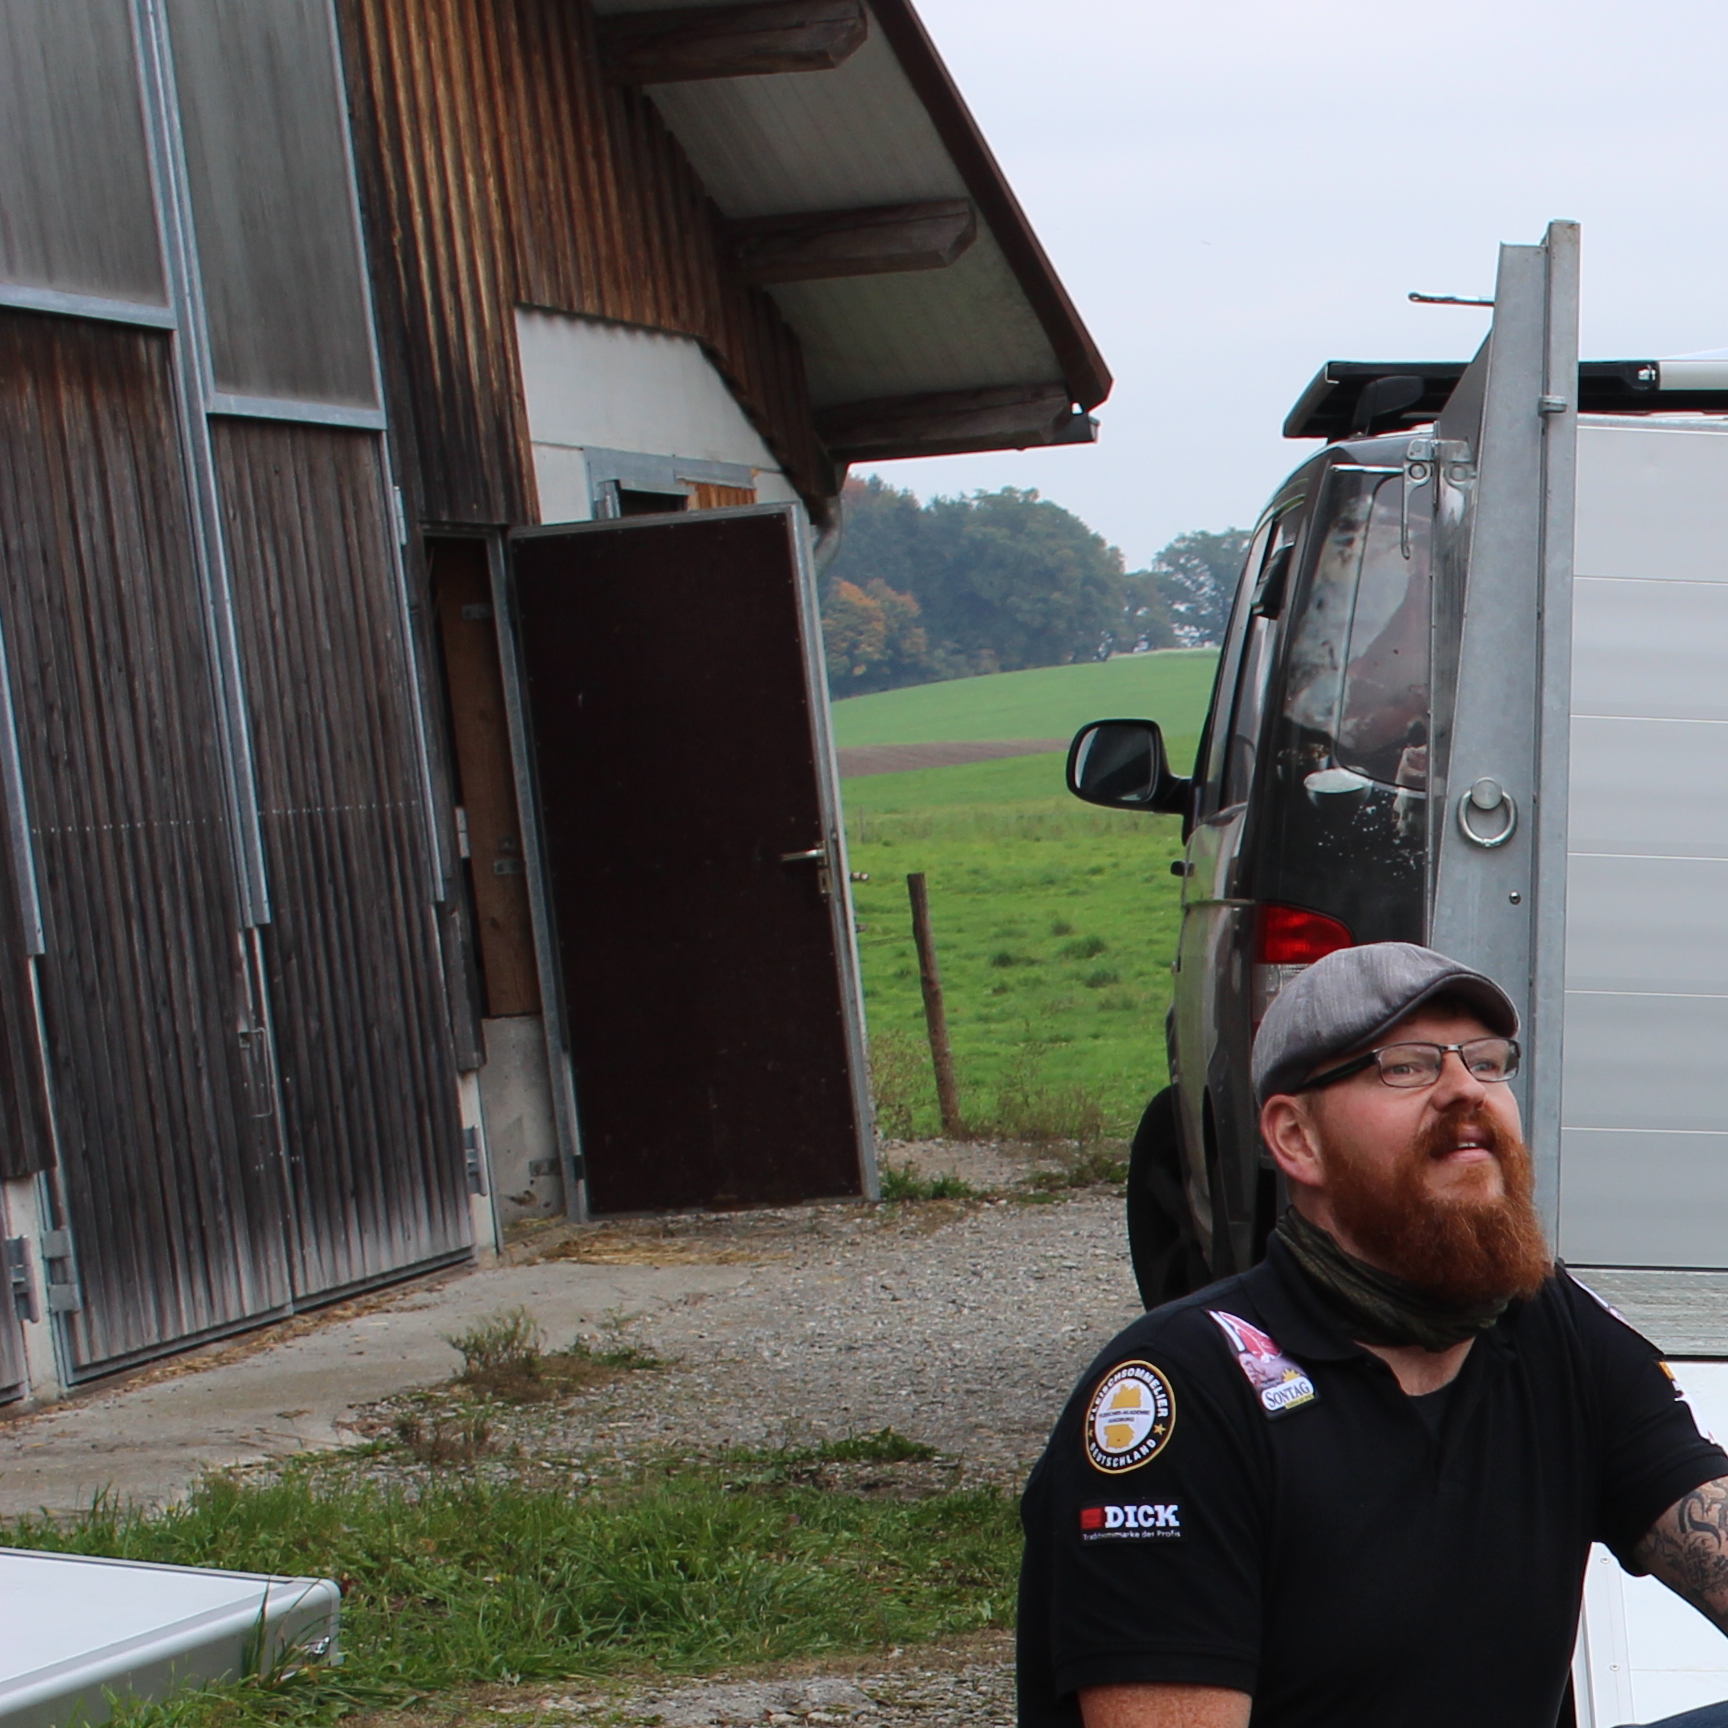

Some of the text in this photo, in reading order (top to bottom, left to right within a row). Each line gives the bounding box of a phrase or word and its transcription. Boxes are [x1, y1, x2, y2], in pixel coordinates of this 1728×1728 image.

[1089, 1367, 1169, 1421] FLEISCHSOMMELIER
[1264, 1381, 1311, 1408] SONTAG
[1090, 1438, 1157, 1468] DEUTSCHLAND
[1104, 1504, 1180, 1528] DICK
[1141, 1530, 1155, 1538] der
[1156, 1529, 1181, 1538] Profis
